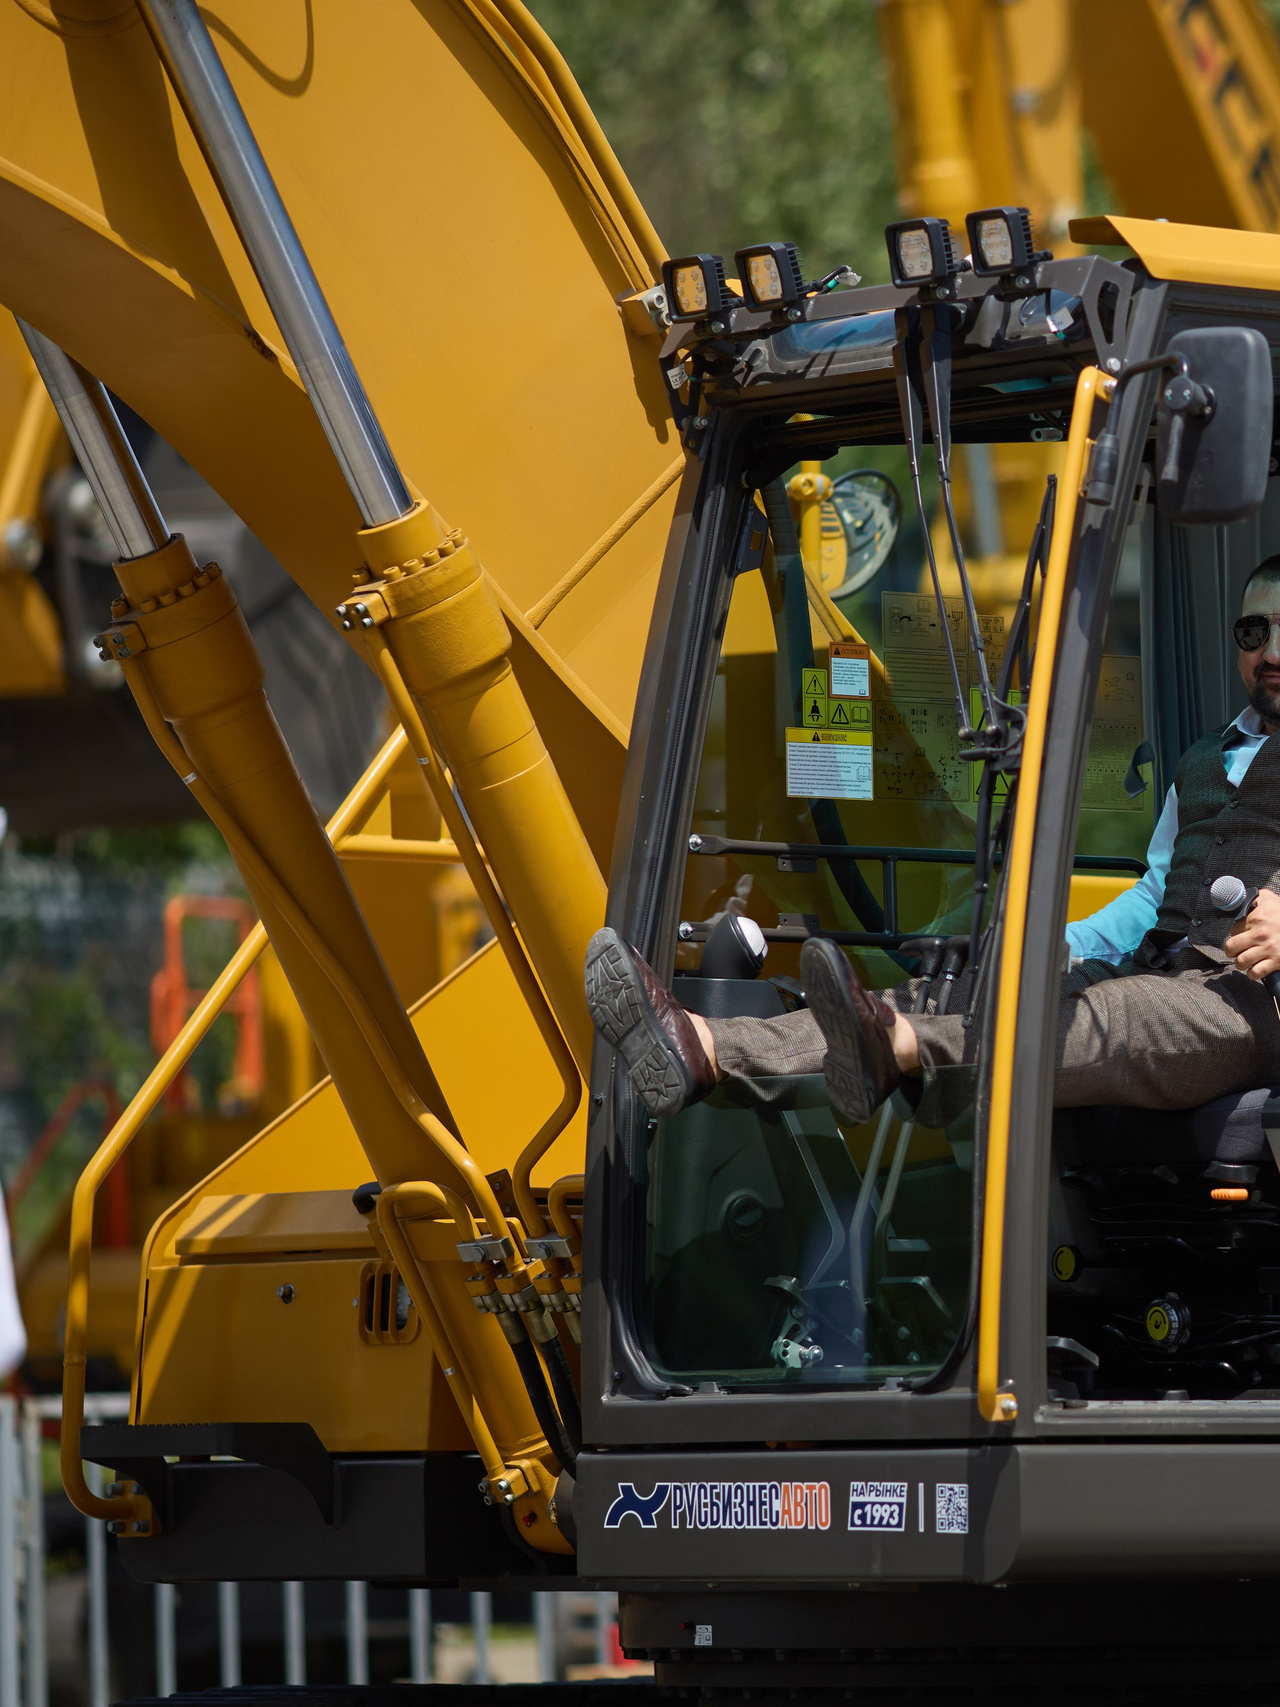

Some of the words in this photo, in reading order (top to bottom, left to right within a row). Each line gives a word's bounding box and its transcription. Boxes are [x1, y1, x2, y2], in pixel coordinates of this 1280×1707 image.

[851, 1484, 865, 1497] НА
[868, 1484, 906, 1498] РЫНКЕ
[672, 1481, 831, 1530] РУСБИЗНЕСАВТО
[864, 1504, 900, 1526] 1993
